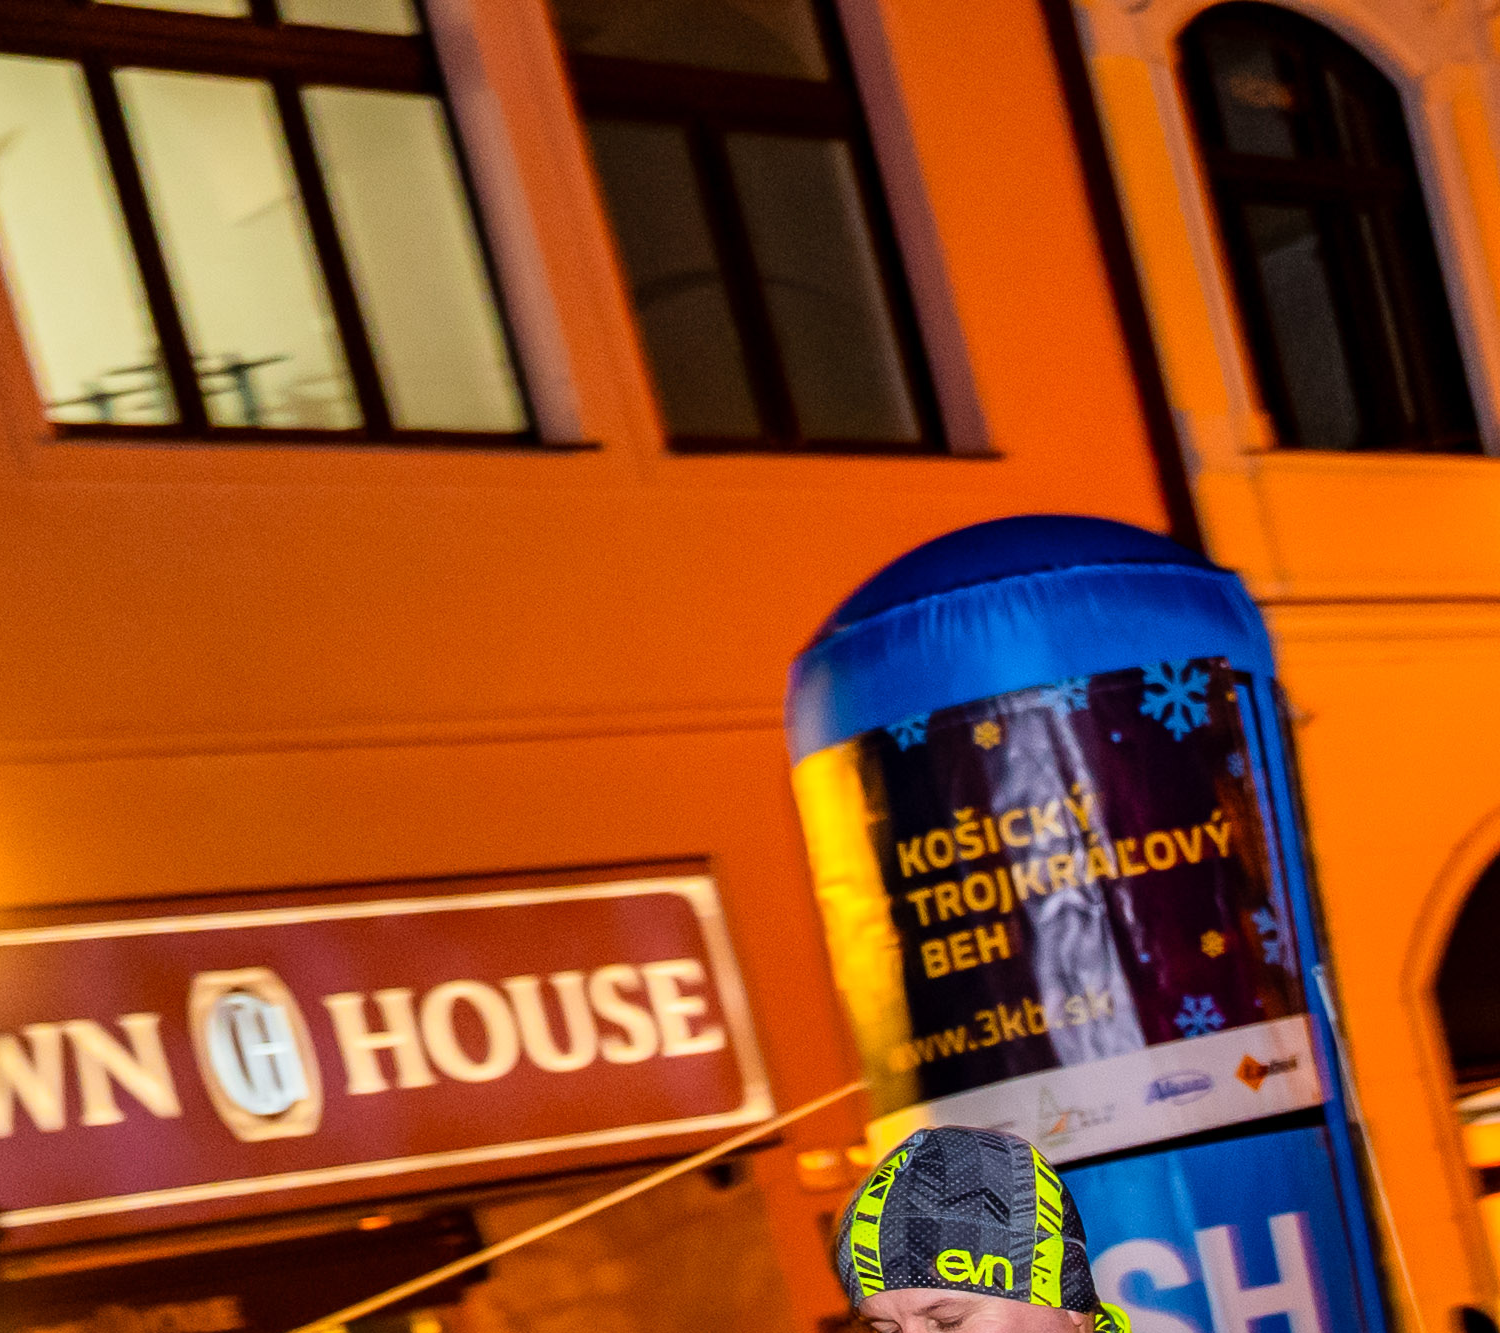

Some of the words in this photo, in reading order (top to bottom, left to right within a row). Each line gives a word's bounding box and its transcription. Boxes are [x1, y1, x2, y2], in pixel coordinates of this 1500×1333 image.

[896, 782, 1095, 878] KOŠICKÝ
[906, 808, 1235, 927] TROJKRÁĽOVÝ
[920, 922, 1011, 979] BEH
[322, 956, 726, 1096] HOUSE
[935, 1248, 1014, 1291] evn
